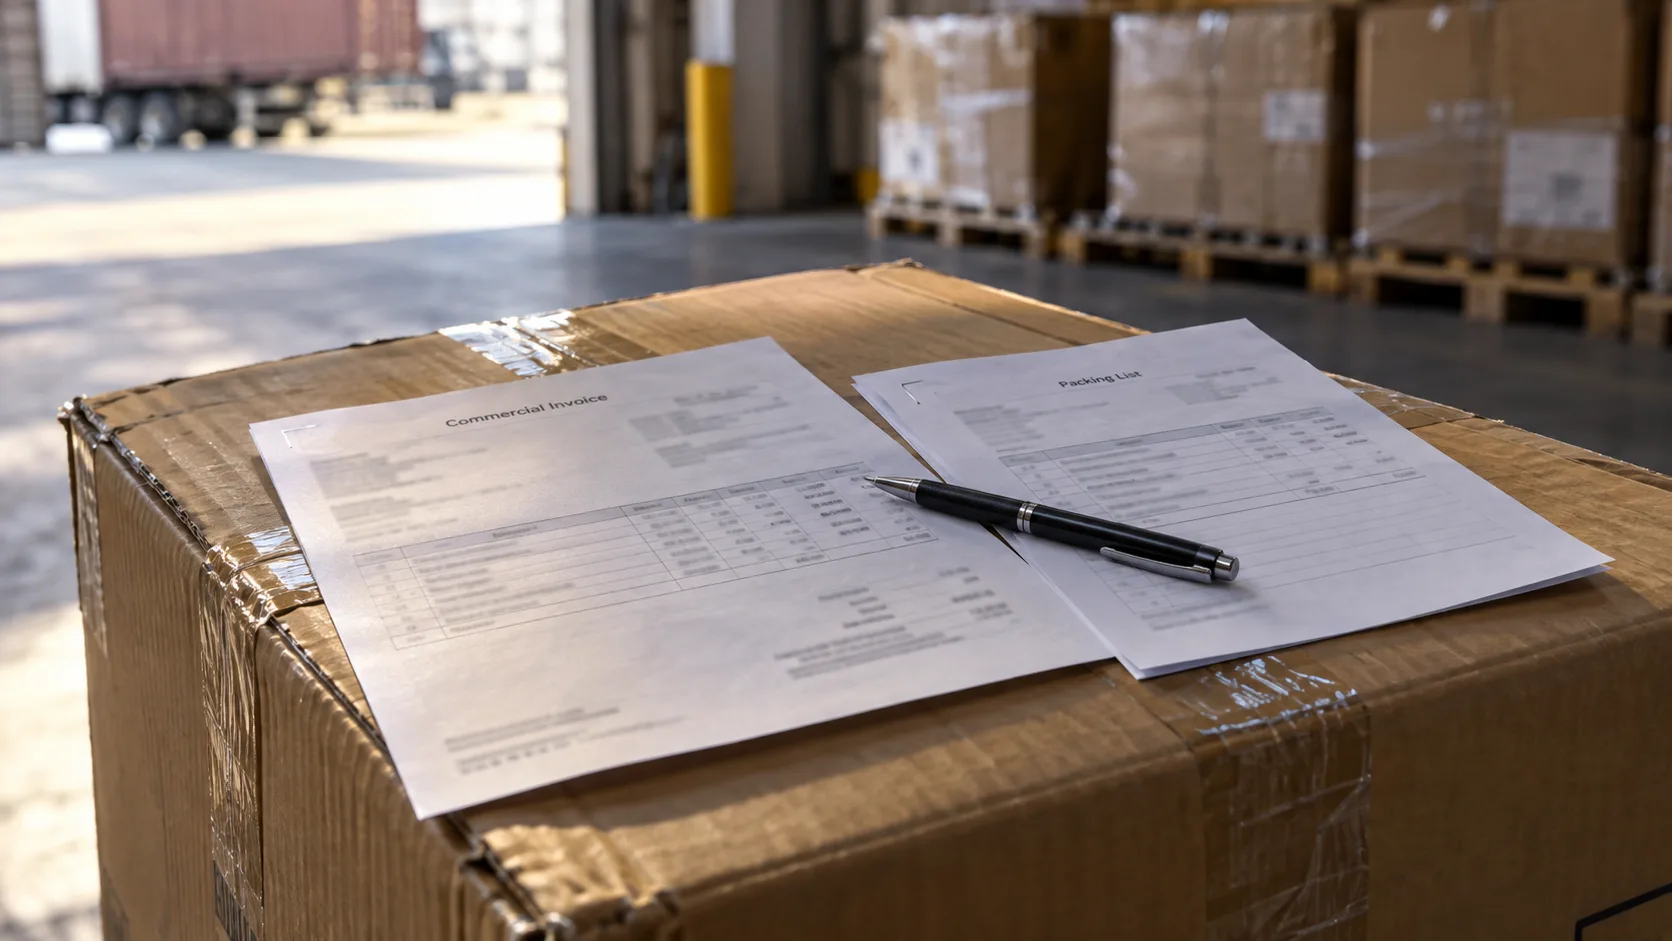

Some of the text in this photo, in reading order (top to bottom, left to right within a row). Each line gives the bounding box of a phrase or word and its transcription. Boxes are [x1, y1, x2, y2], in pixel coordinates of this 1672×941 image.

[1058, 371, 1142, 388] Packing List
[445, 394, 608, 428] Commercial Invoice
